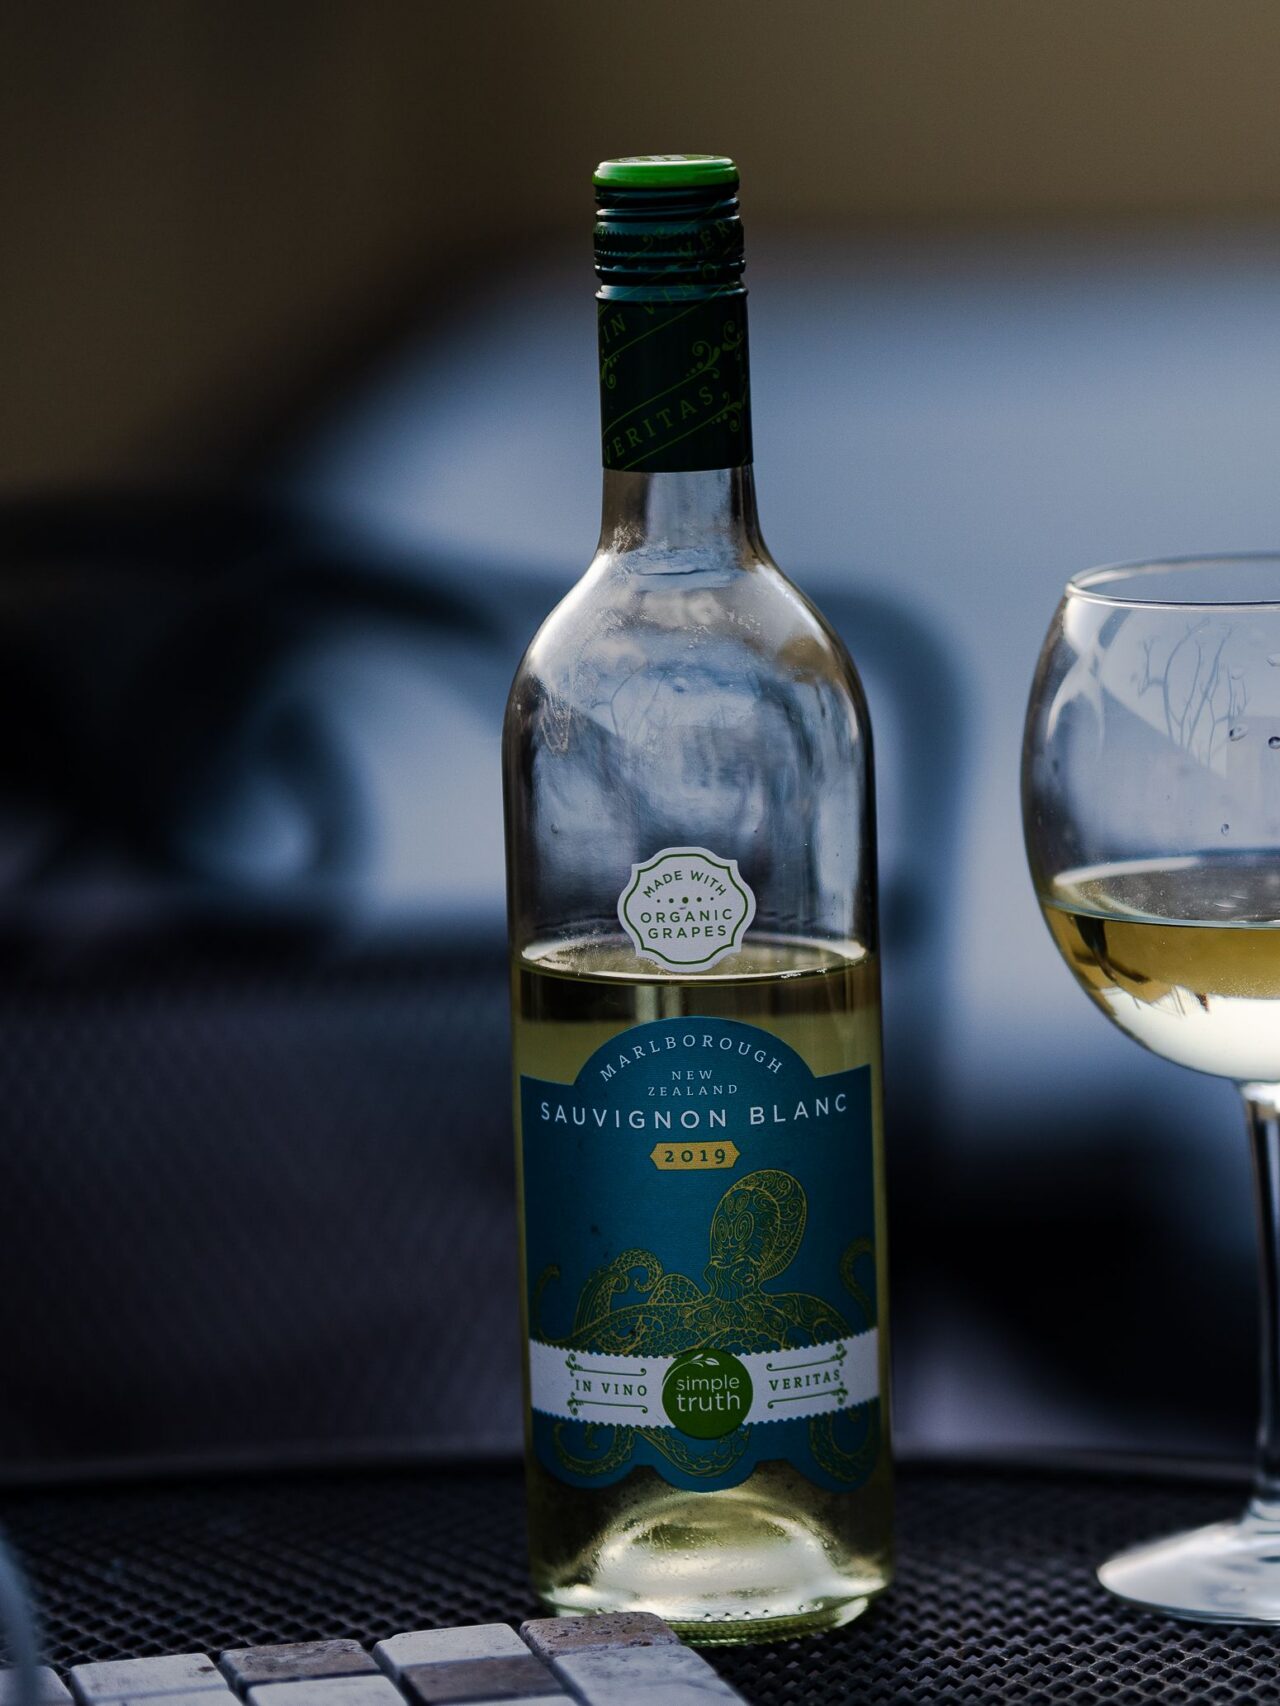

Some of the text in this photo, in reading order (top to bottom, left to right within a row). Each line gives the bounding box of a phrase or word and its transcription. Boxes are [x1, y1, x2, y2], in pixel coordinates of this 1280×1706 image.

[604, 385, 714, 465] VERITAS
[642, 870, 727, 898] MADE WITH
[640, 908, 733, 924] ORGANIC
[647, 924, 727, 939] GRAPES
[600, 1034, 784, 1082] MARLBOROUGH
[671, 1069, 714, 1081] NEW
[647, 1083, 739, 1097] ZEALAND
[540, 1093, 848, 1129] SAUVIGNON BLANC
[664, 1148, 727, 1164] 2019
[575, 1379, 648, 1397] IN VINO
[675, 1374, 741, 1394] simple
[768, 1369, 842, 1391] VERITAS
[675, 1391, 741, 1412] truth
